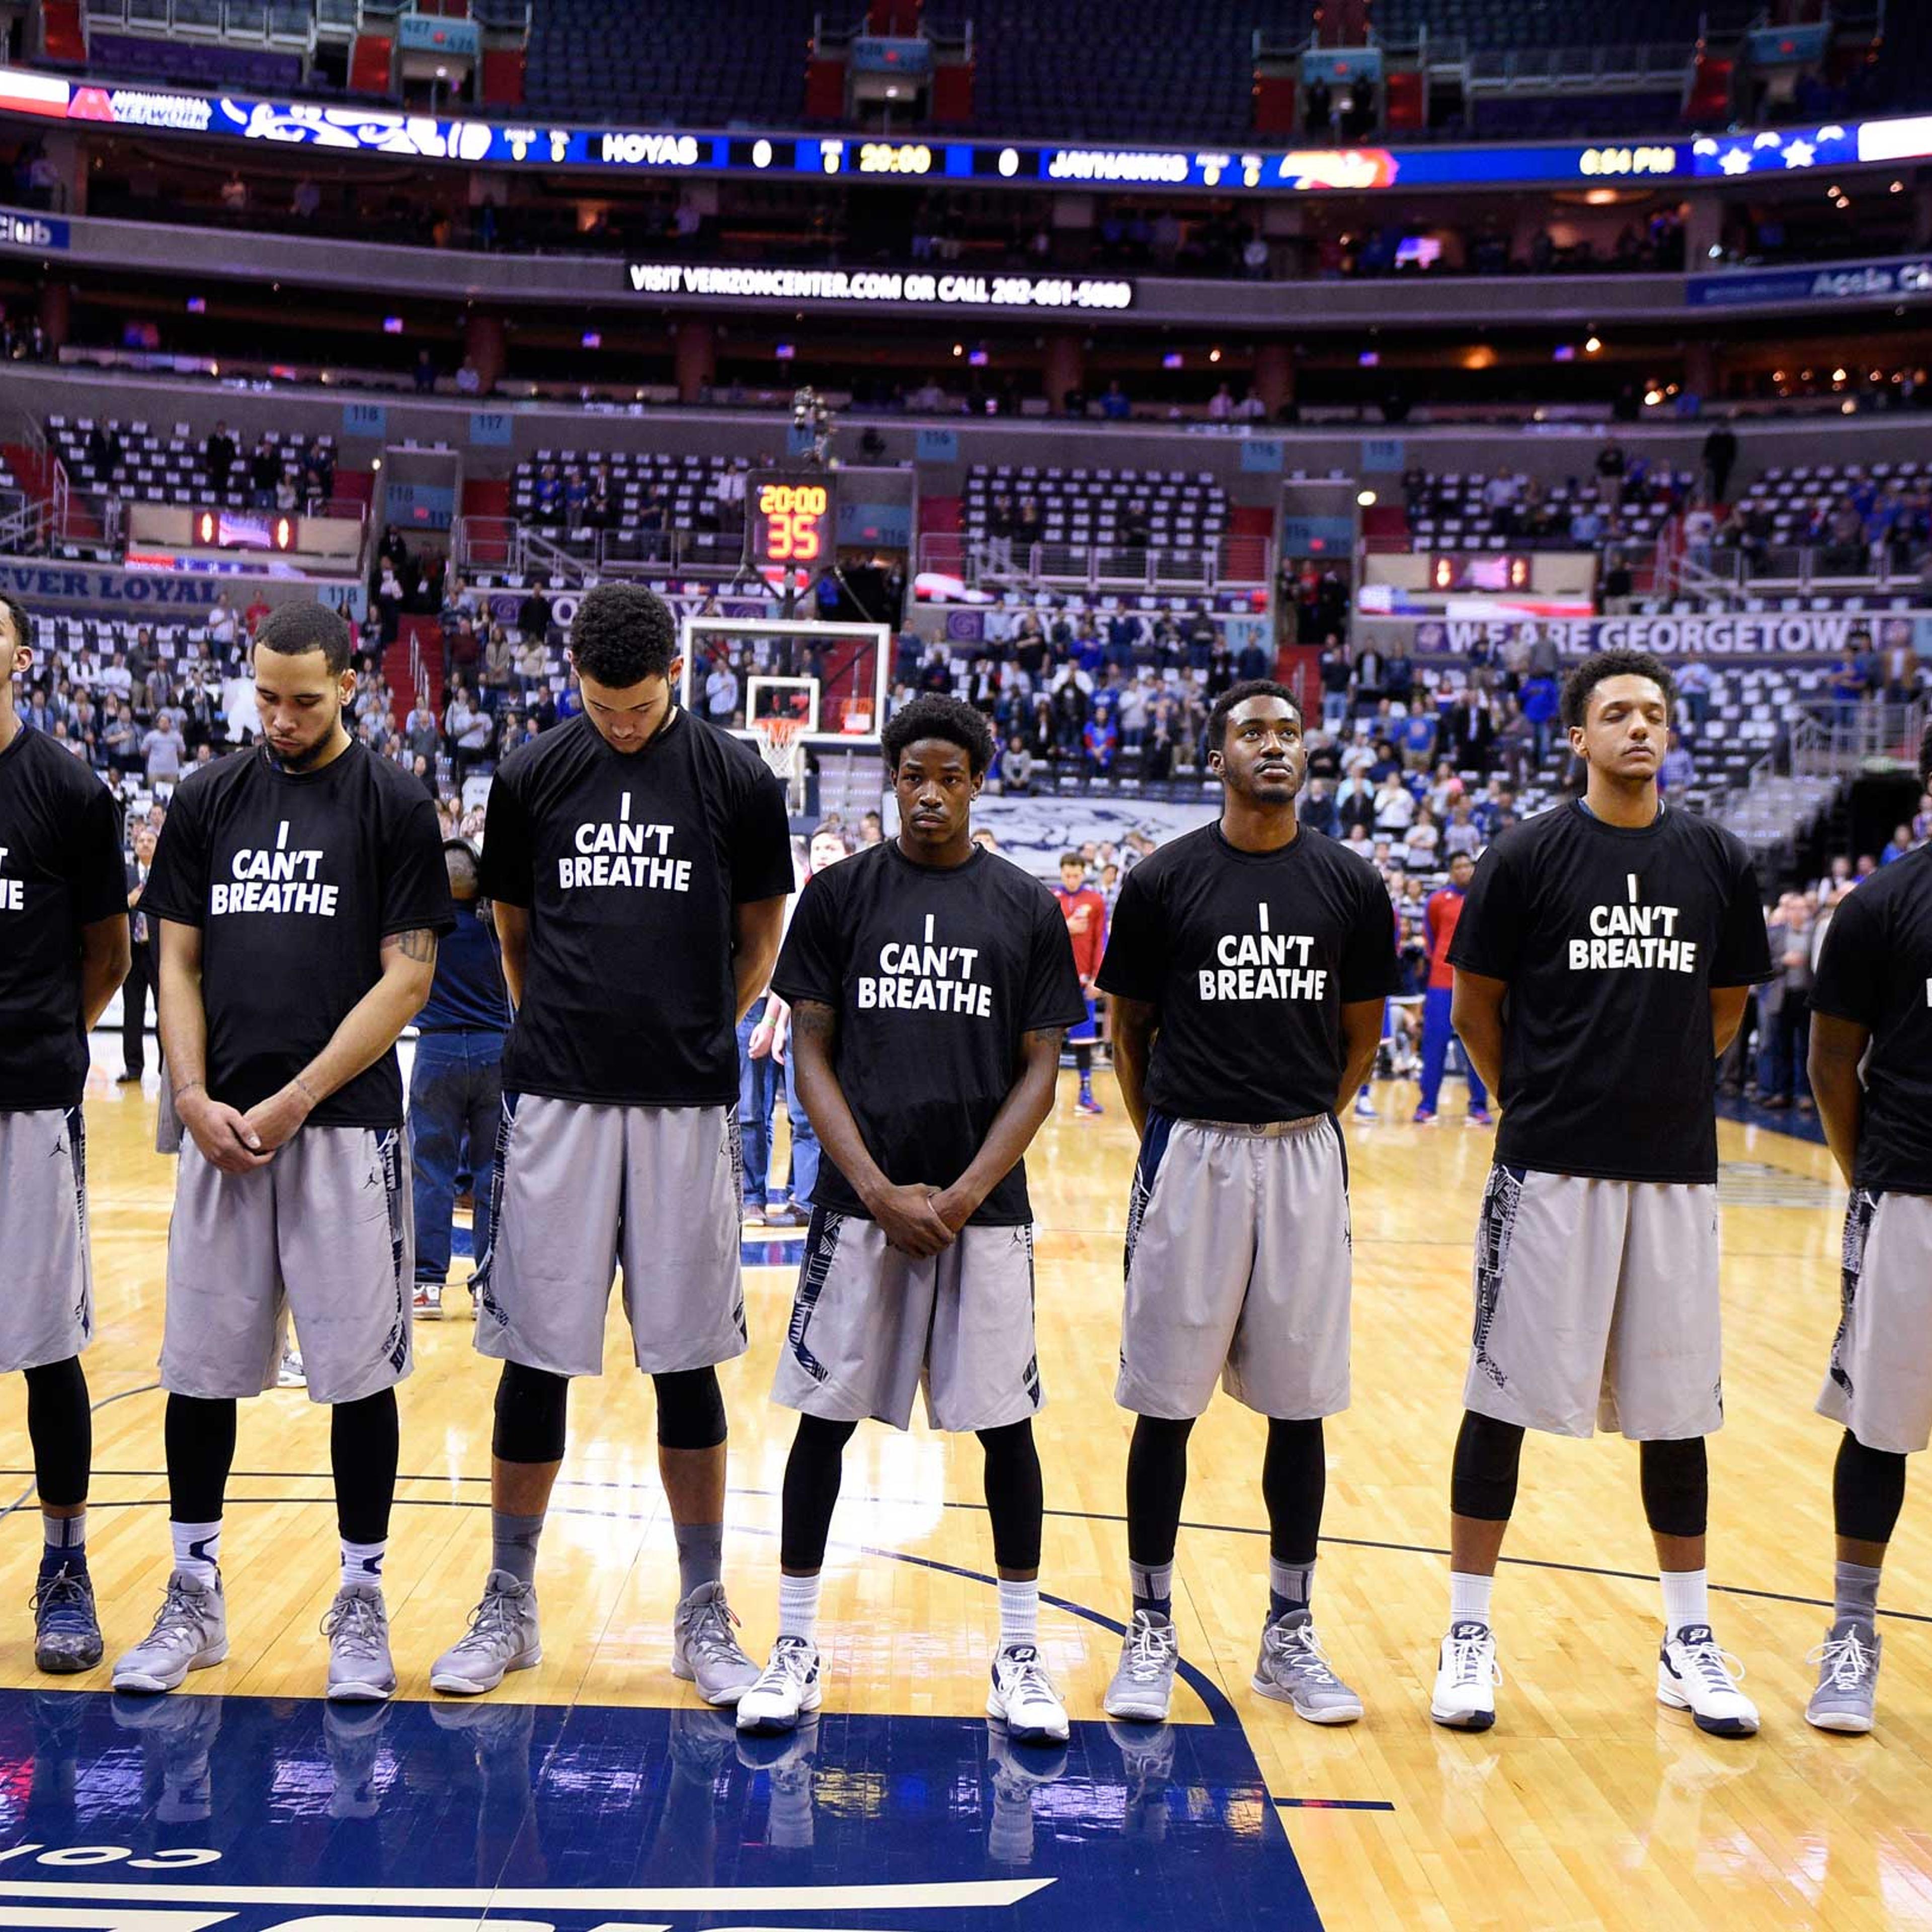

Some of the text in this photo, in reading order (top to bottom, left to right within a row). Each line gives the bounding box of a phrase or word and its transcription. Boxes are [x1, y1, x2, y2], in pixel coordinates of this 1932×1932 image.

[603, 133, 698, 165] HOYAS
[753, 139, 772, 168] 0
[999, 148, 1019, 177] 0
[630, 265, 682, 291] VISIT
[683, 267, 902, 300] VERIZONCENTER.COM
[904, 275, 936, 300] OR
[938, 276, 990, 303] CALL
[479, 414, 503, 429] 117
[760, 485, 827, 515] 20:00
[767, 513, 819, 559] 35
[620, 792, 631, 821] I
[276, 821, 289, 849] I
[575, 823, 674, 855] CAN'T
[232, 849, 323, 880] CAN'T
[559, 855, 692, 892] BREATHE
[211, 881, 339, 916] BREATHE
[1627, 873, 1637, 903] I
[925, 914, 934, 943] I
[1259, 903, 1269, 932] I
[1590, 906, 1678, 937] CAN'T
[880, 943, 978, 980] CAN'T
[1217, 935, 1314, 967] CAN'T
[1569, 938, 1696, 973] BREATHE
[858, 977, 992, 1018] BREATHE
[1199, 968, 1327, 1001] BREATHE
